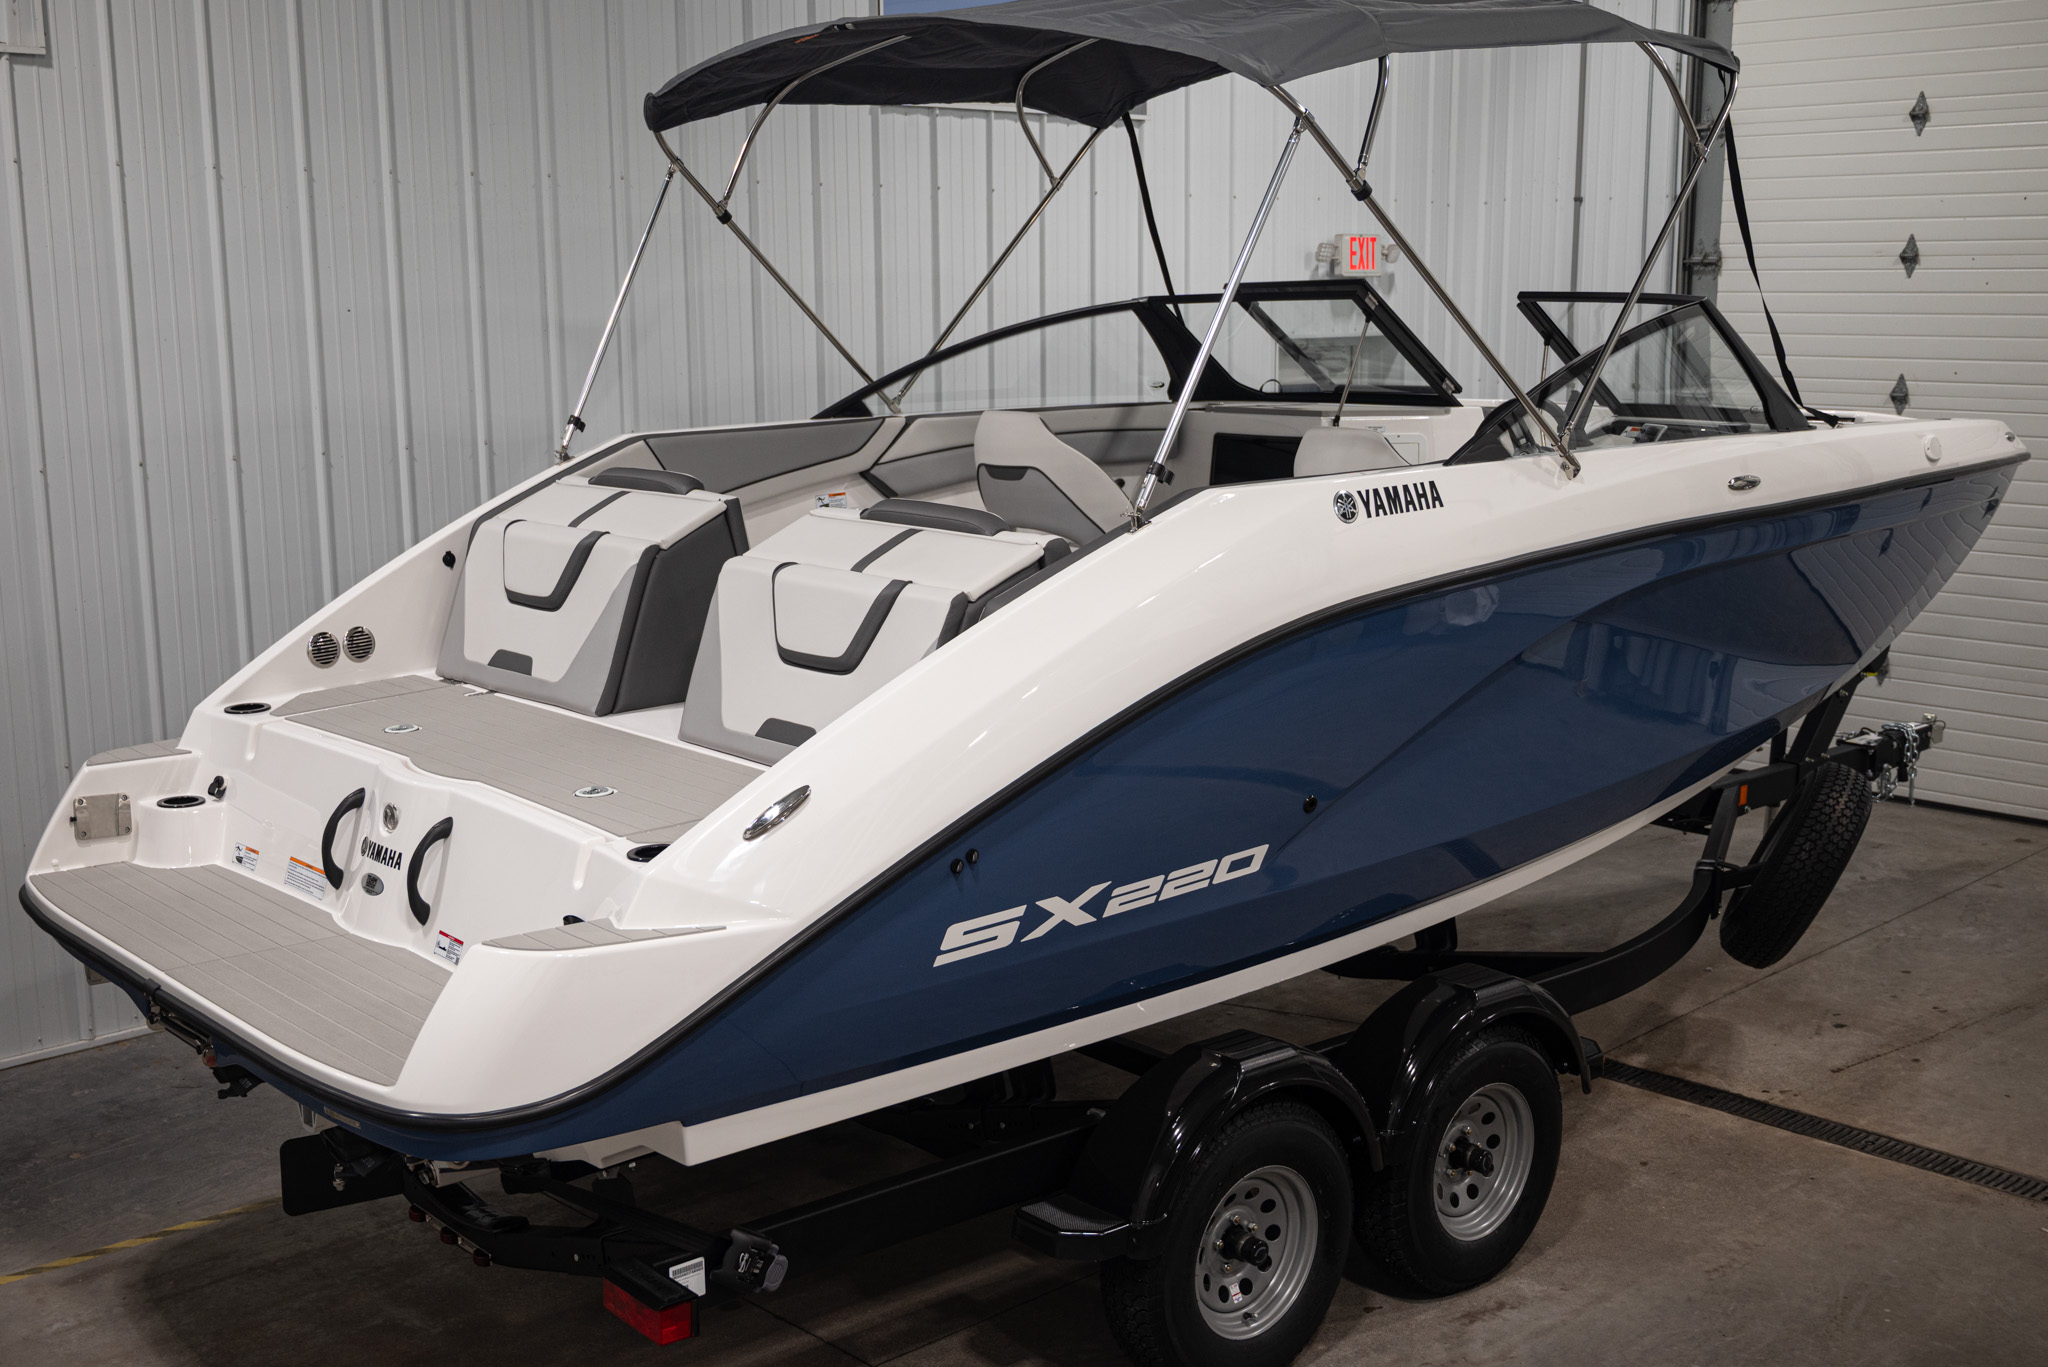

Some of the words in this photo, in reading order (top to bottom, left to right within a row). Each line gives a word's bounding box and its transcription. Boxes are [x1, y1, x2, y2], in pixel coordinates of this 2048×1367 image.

[1349, 236, 1377, 270] EXIT
[1356, 480, 1444, 519] YAMAHA
[366, 839, 403, 871] YAMAHA
[932, 843, 1270, 968] SX220
